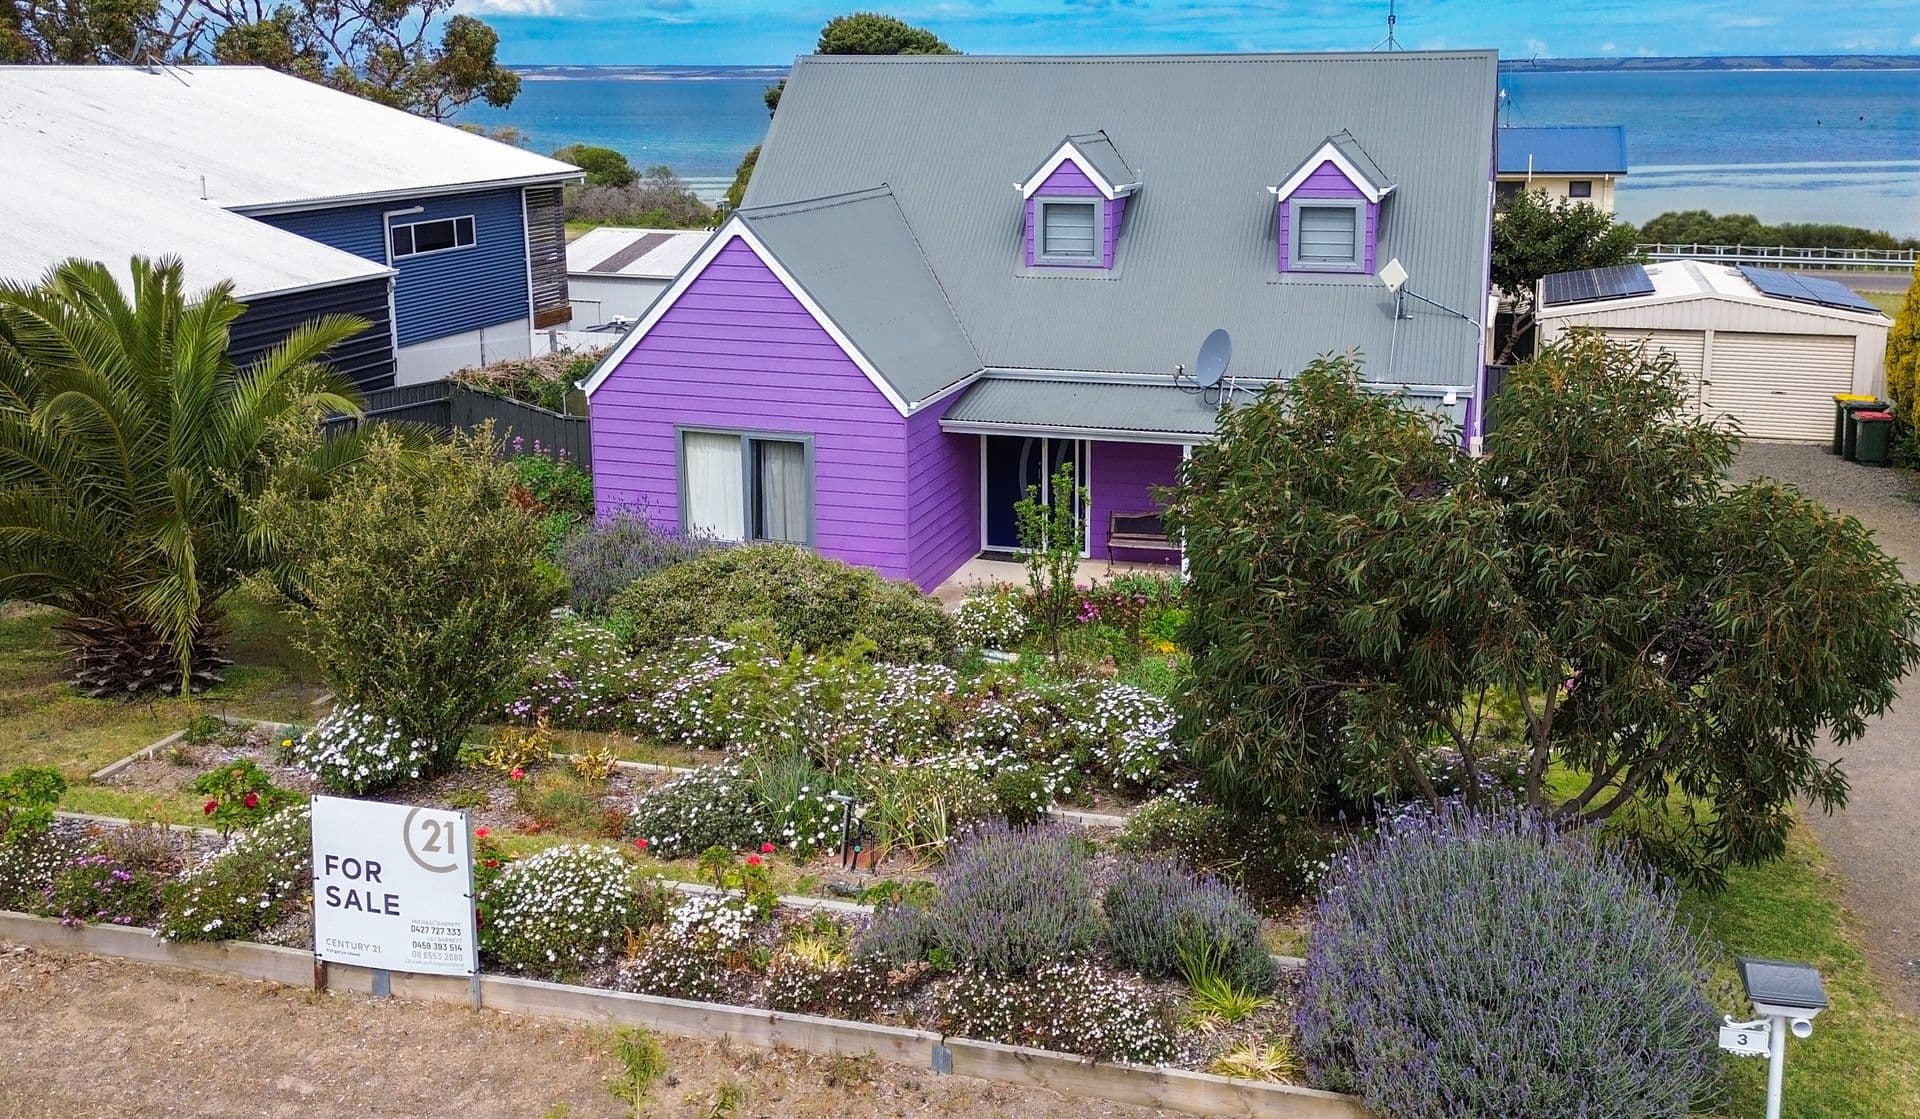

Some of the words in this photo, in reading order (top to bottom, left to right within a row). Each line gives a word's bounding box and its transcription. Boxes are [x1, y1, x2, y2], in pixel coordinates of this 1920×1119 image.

[325, 854, 382, 883] FOR
[326, 885, 400, 916] SALE
[411, 925, 429, 935] 0427
[431, 927, 445, 935] 727
[446, 928, 462, 936] 333
[325, 938, 370, 951] CENTURY
[372, 944, 381, 953] 21
[449, 943, 462, 952] 514
[1737, 1033, 1748, 1045] 3
